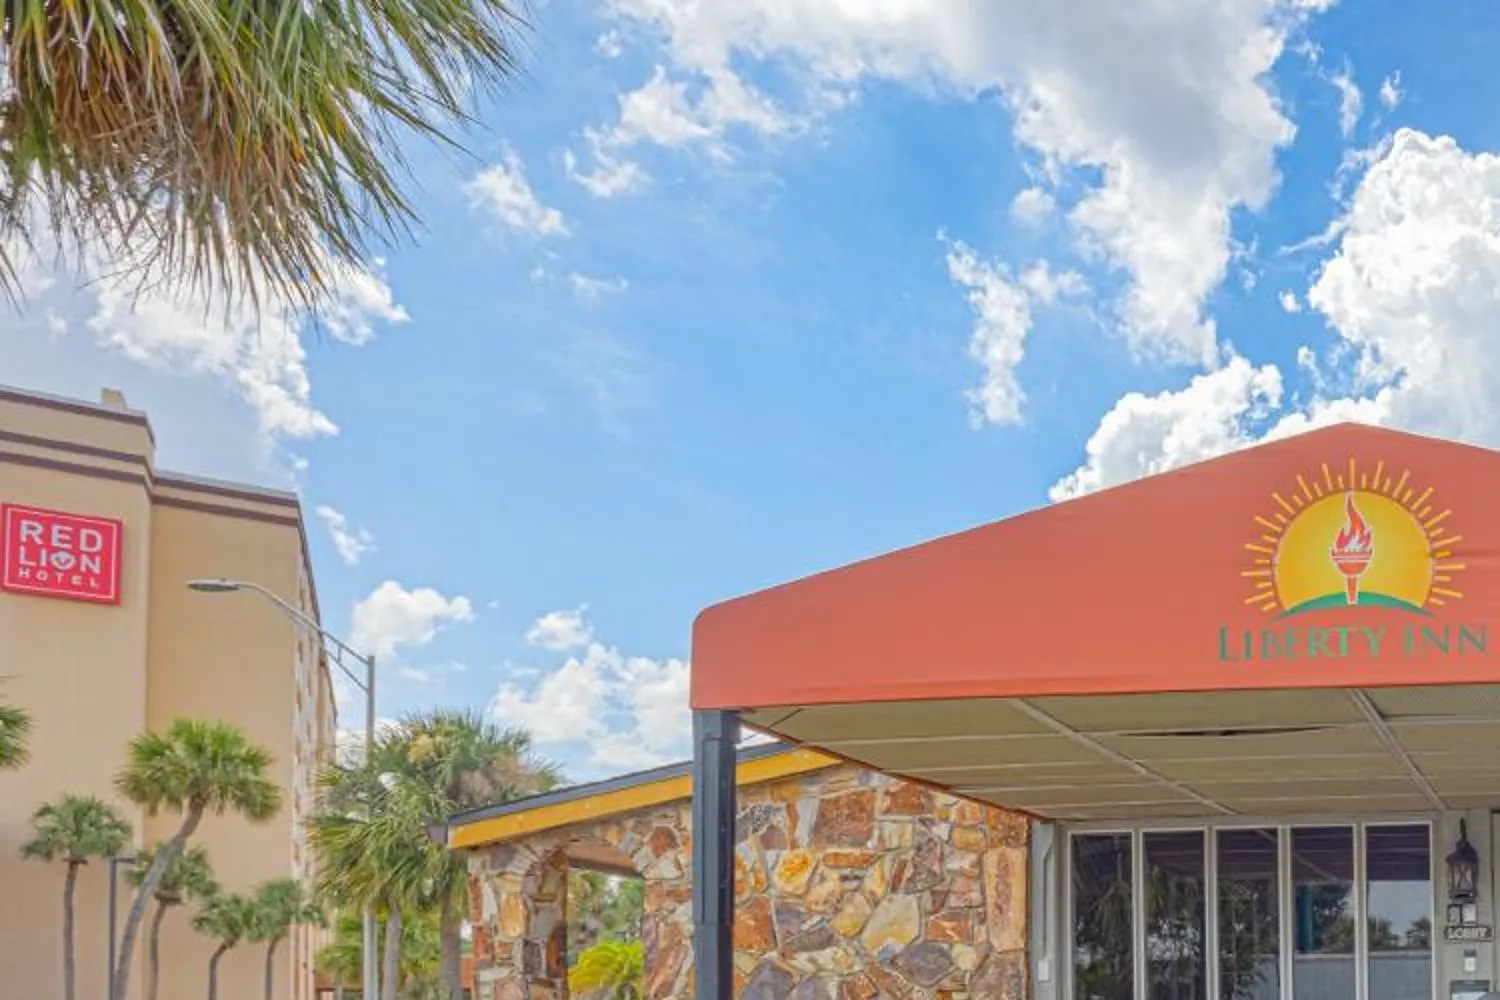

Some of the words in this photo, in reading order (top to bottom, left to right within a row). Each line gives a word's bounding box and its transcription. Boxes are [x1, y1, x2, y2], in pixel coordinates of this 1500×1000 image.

[20, 519, 103, 553] RED
[19, 545, 101, 574] LION
[18, 567, 99, 589] HOTEL
[1218, 624, 1388, 662] LIBERTY
[1402, 624, 1488, 657] INN
